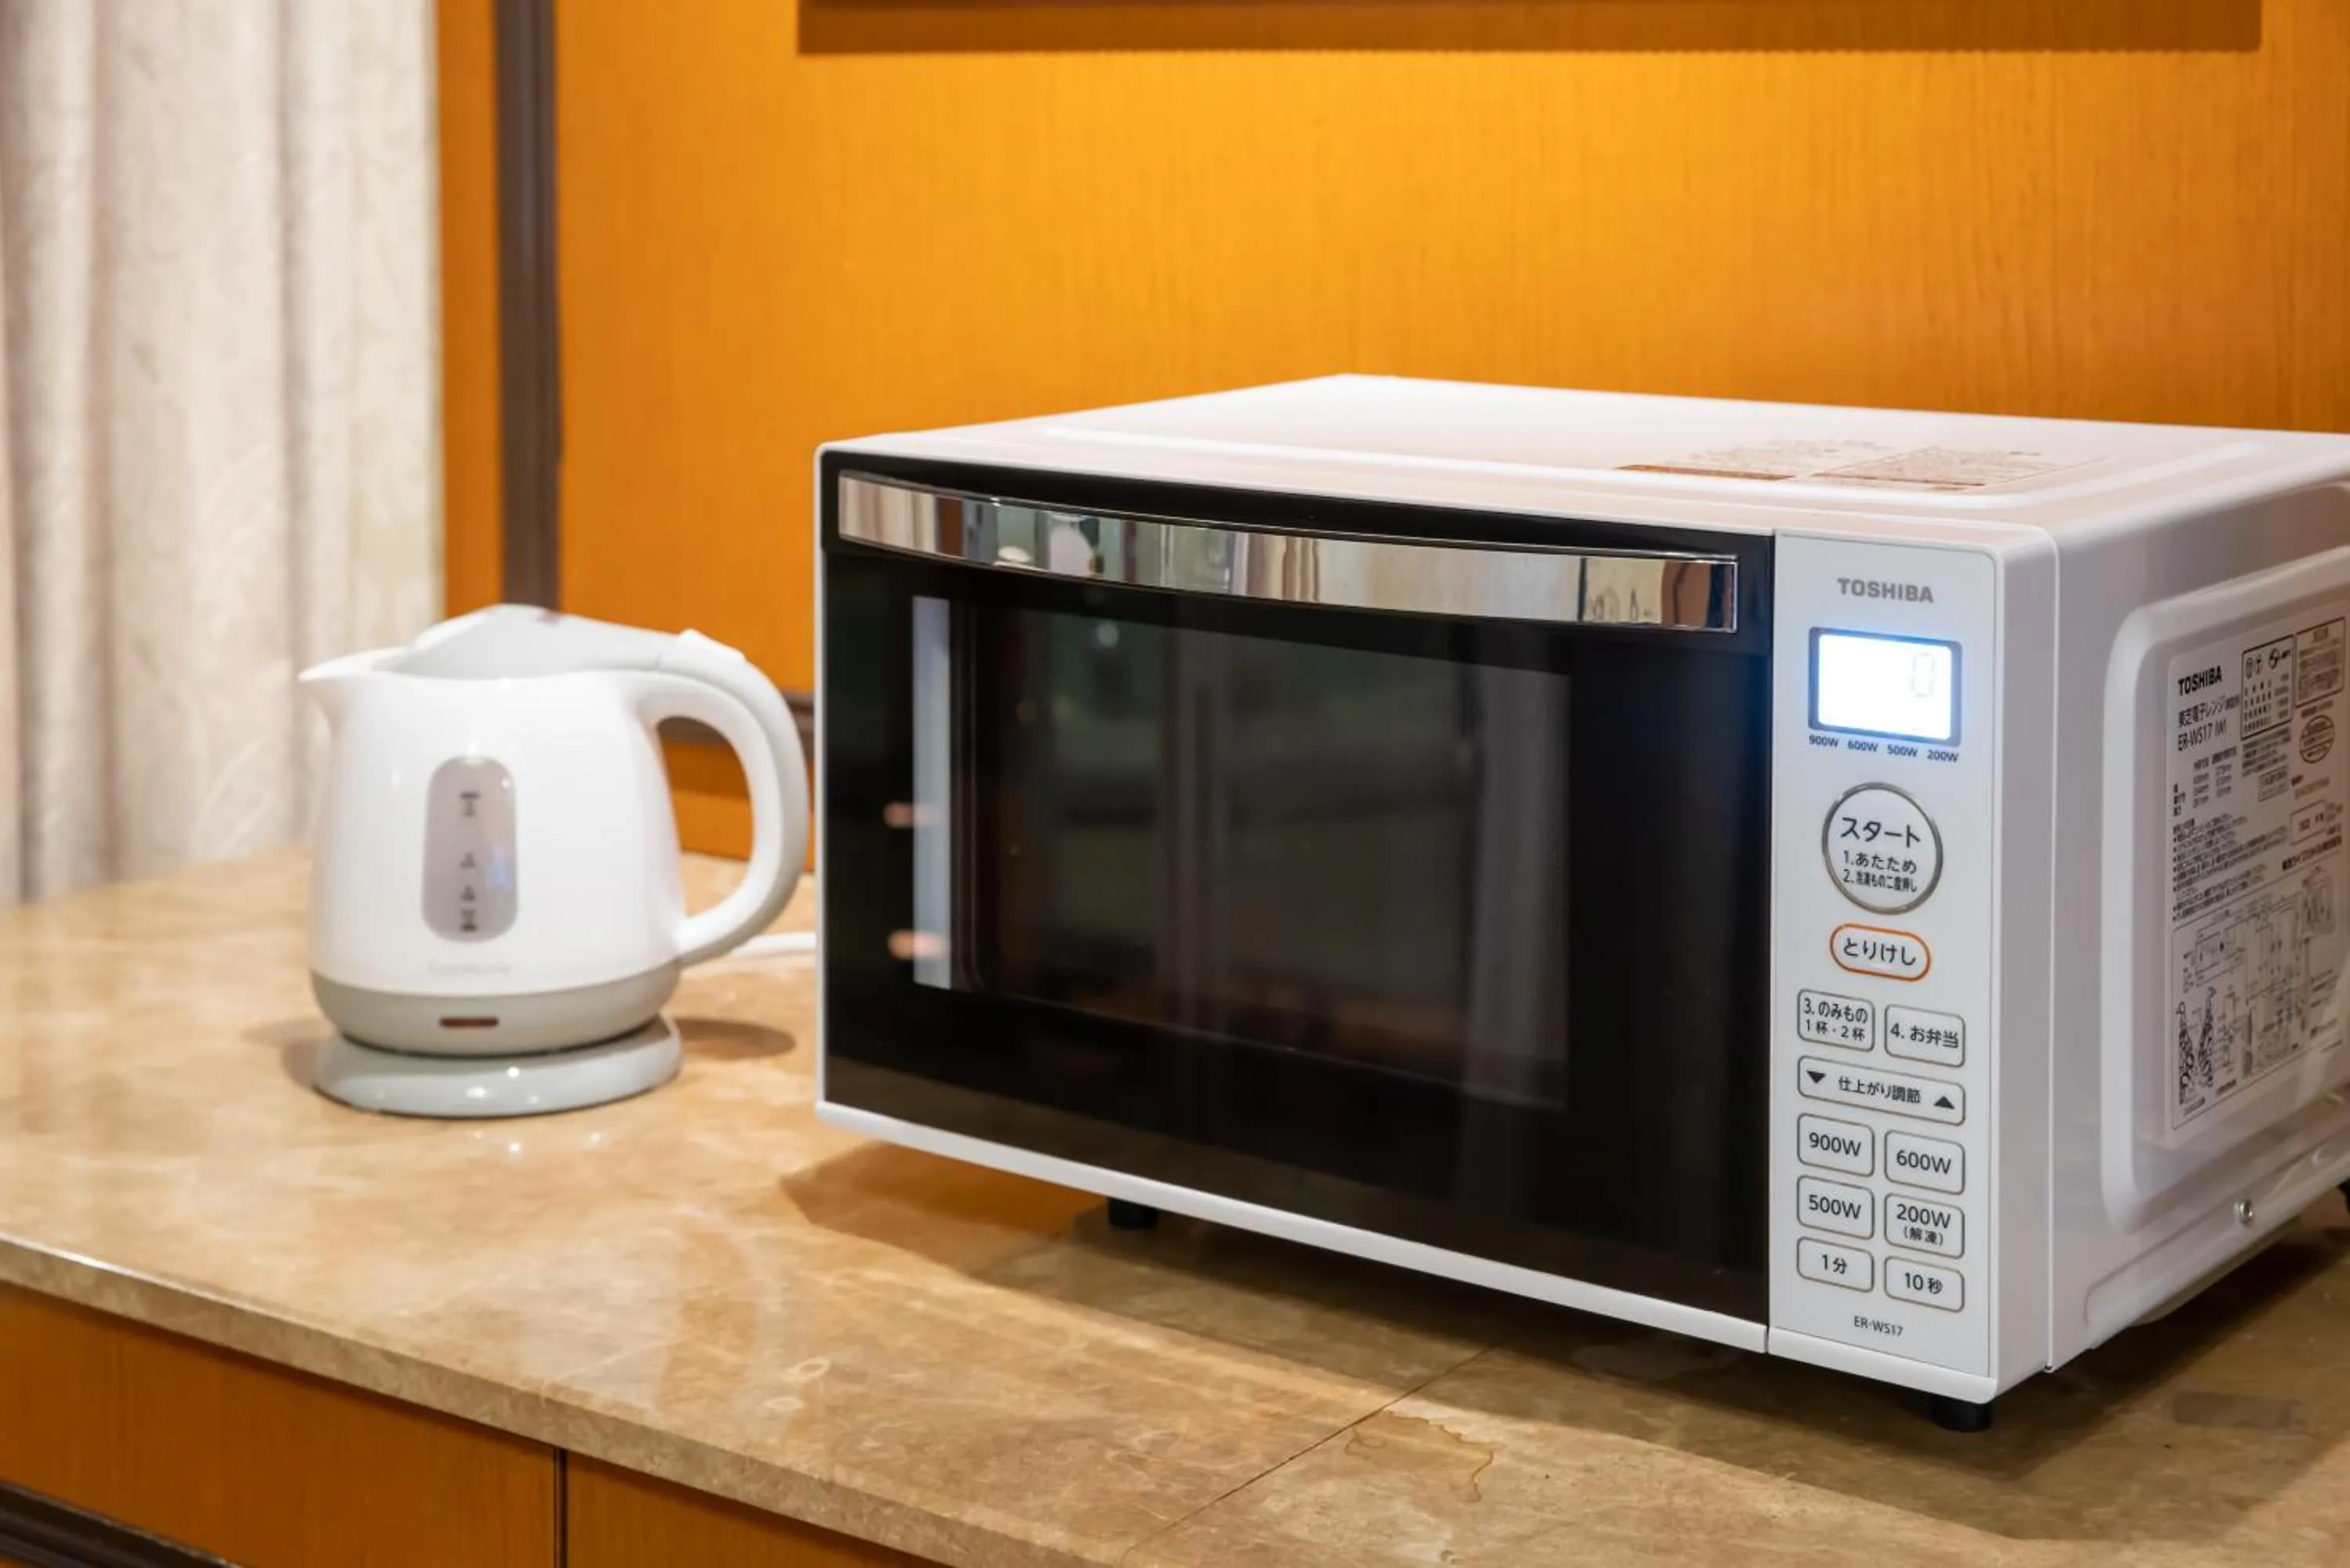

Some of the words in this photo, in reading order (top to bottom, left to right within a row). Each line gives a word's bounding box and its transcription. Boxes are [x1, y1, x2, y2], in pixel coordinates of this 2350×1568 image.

[1838, 578, 1933, 603] TOSHIBA
[2178, 665, 2222, 695] TOSHIBA
[1809, 735, 1839, 748] 900W
[1847, 739, 1878, 753] 600W
[1887, 745, 1918, 757] 500W
[1926, 750, 1959, 763] 200W
[1841, 817, 1921, 848] スタート
[1843, 938, 1916, 966] とりけし
[1809, 1132, 1861, 1157] 900W
[1896, 1150, 1950, 1174] 600W
[1809, 1194, 1861, 1219] 500W
[1896, 1204, 1950, 1229] 200W
[1854, 1315, 1904, 1336] ER-WS17
